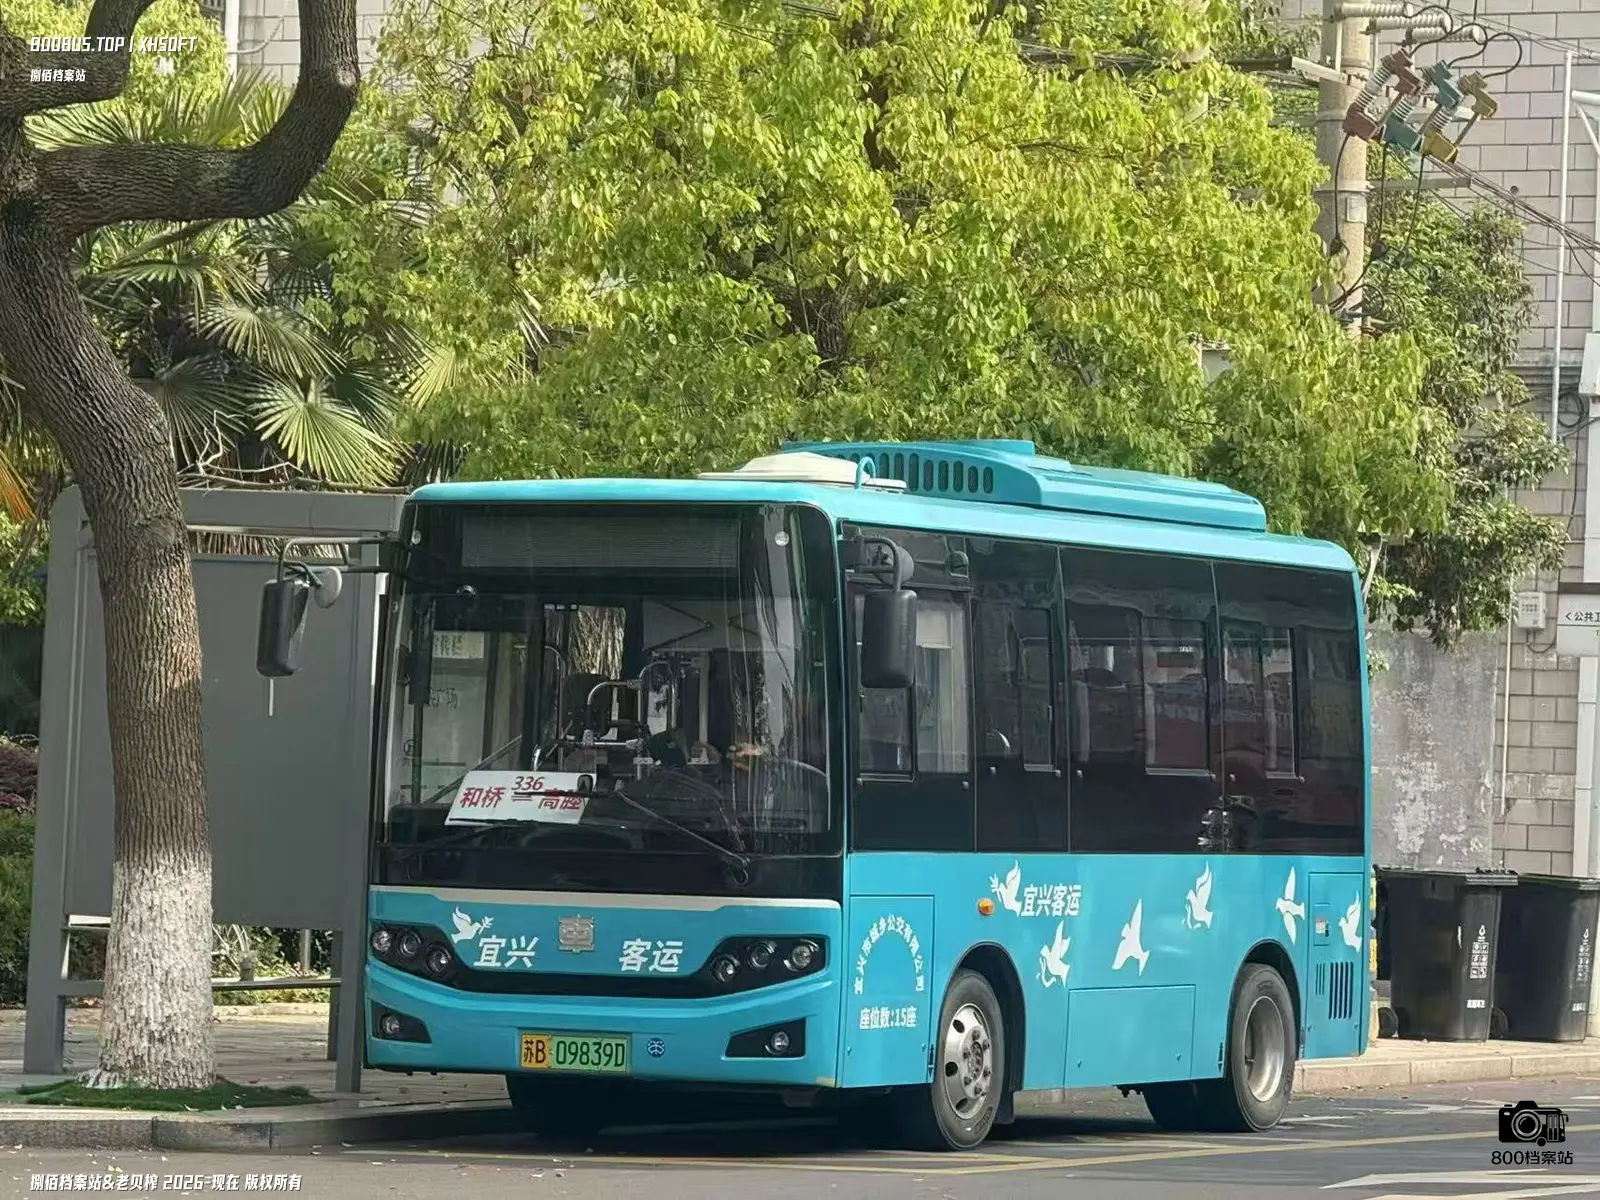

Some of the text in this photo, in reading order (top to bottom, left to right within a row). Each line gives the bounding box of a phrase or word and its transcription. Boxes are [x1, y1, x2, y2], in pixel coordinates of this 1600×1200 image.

[460, 786, 506, 808] 和桥
[511, 776, 545, 791] 336
[1021, 883, 1081, 917] 宜兴客运
[474, 935, 683, 973] 宜兴 客运
[523, 1038, 625, 1067] 苏B 09839D
